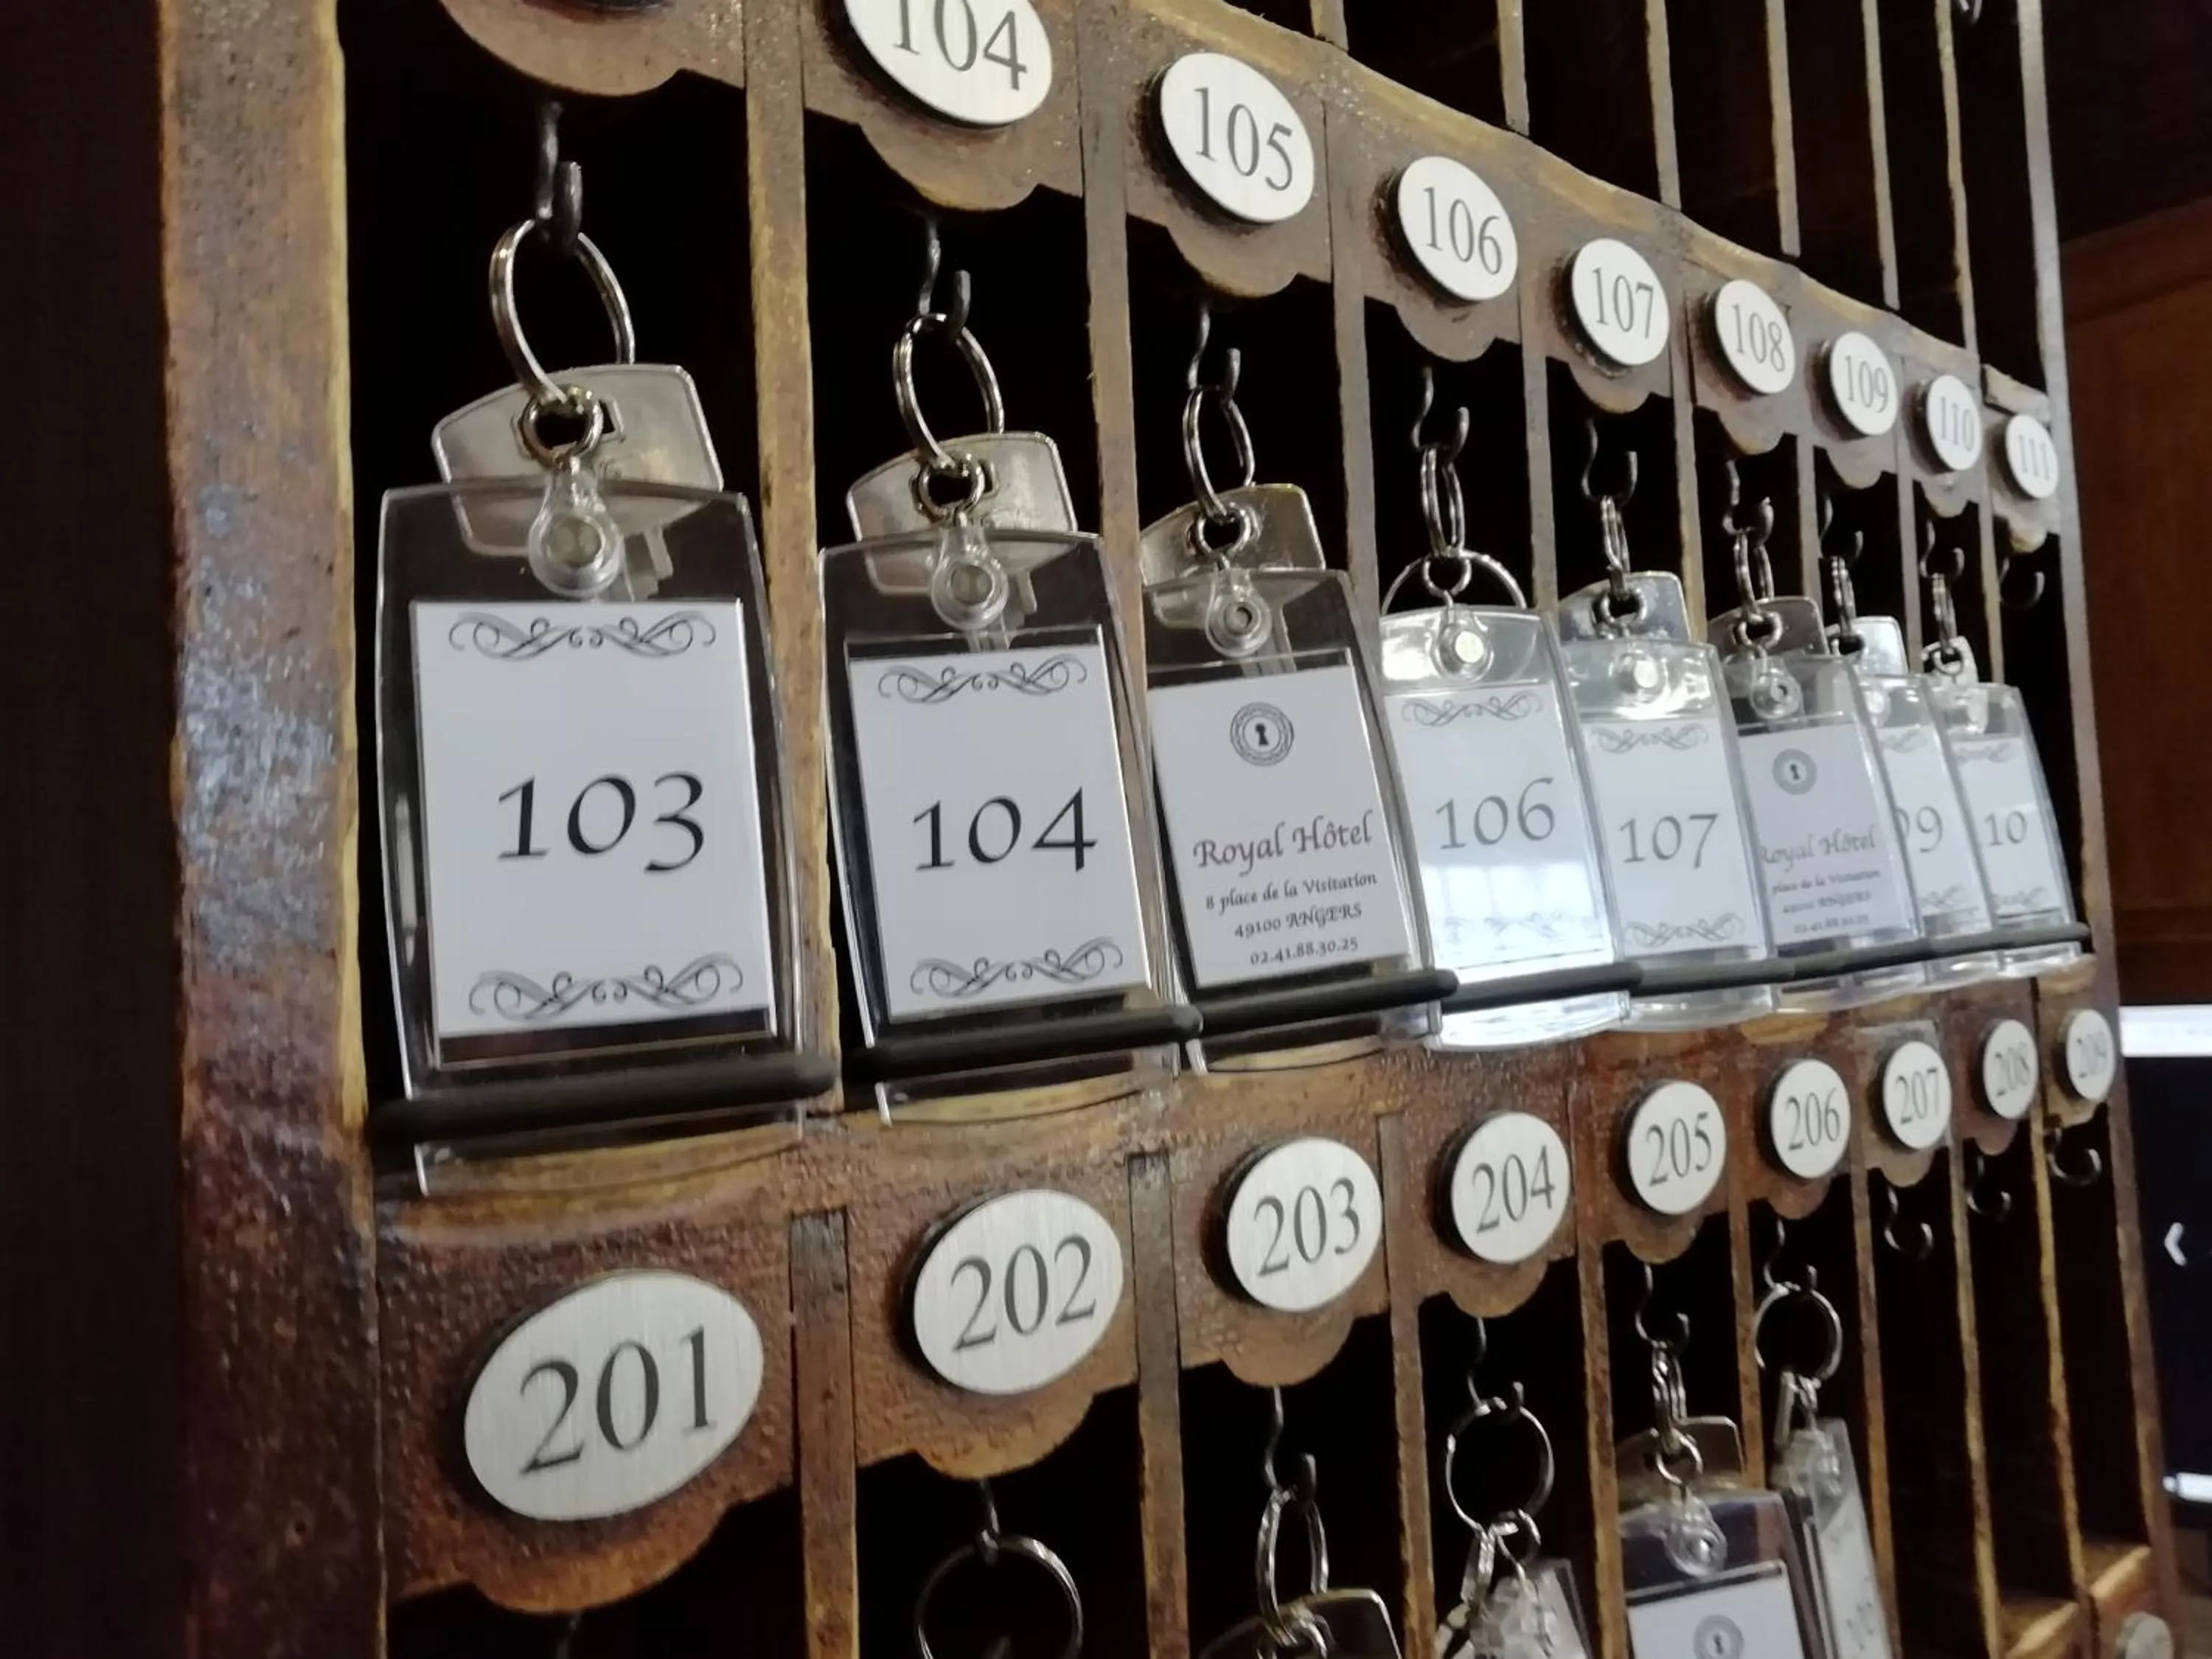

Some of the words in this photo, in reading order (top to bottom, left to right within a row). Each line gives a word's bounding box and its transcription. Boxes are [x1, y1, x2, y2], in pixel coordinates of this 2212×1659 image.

[893, 0, 1027, 91] 104
[1194, 88, 1293, 191] 105
[1423, 187, 1503, 276] 106
[1593, 268, 1654, 339] 107
[1732, 304, 1786, 372] 108
[1845, 355, 1888, 413] 109
[1940, 396, 1975, 452] 110
[2018, 434, 2050, 481] 111
[497, 771, 705, 874] 103
[912, 786, 1096, 873] 104
[1192, 821, 1285, 877] Royal
[1293, 808, 1373, 855] Hôtel
[1436, 777, 1556, 849] 106
[1619, 813, 1719, 870] 107
[1985, 810, 2028, 846] 10
[1206, 895, 1215, 911] 8
[1219, 887, 1259, 917] place
[1262, 882, 1280, 903] de
[1284, 879, 1298, 898] la
[1302, 872, 1378, 895] Visitation
[1234, 918, 1281, 939] 49100
[1285, 902, 1363, 928] ANGERS
[1249, 936, 1359, 966] 02.41.88.30.25
[1785, 1088, 1841, 1151] 206
[1895, 1066, 1940, 1126] 207
[1646, 1111, 1712, 1187] 205
[1472, 1144, 1555, 1234] 204
[1254, 1177, 1361, 1278] 203
[950, 1232, 1097, 1352] 202
[519, 1323, 718, 1475] 201
